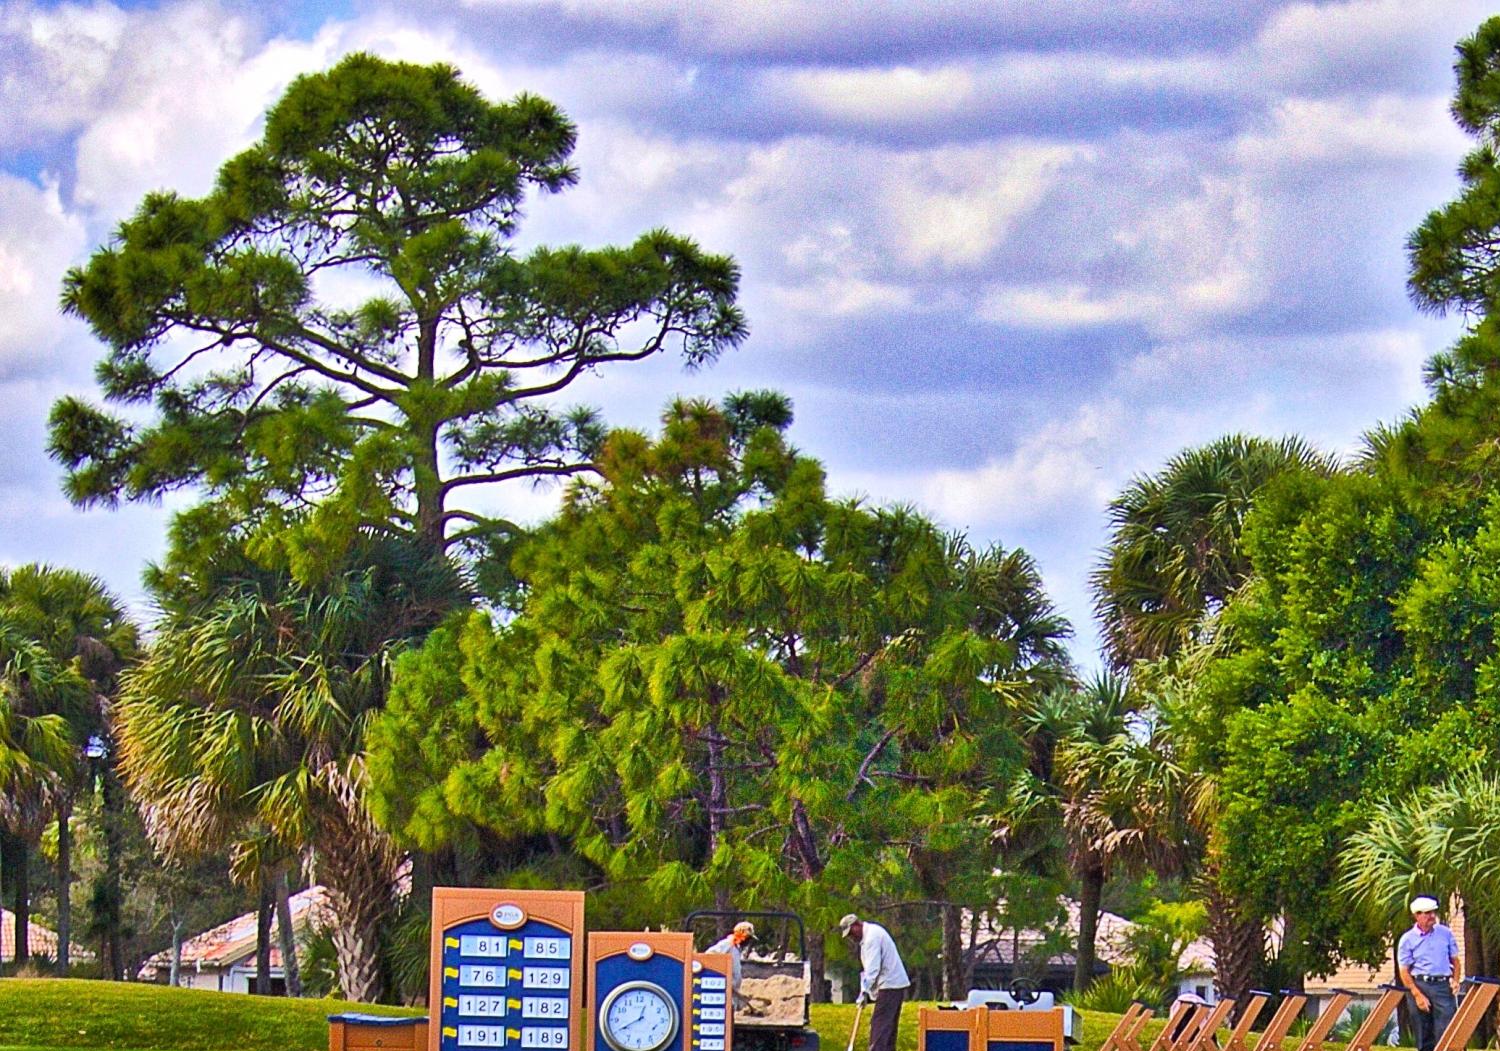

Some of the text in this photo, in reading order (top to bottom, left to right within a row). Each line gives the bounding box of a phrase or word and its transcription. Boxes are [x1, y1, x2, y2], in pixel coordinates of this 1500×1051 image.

[479, 941, 500, 952] 81
[536, 943, 557, 953] 85
[473, 971, 494, 981] 76
[530, 973, 561, 984] 129
[467, 1001, 499, 1011] 127
[529, 1002, 561, 1013] 182
[467, 1030, 497, 1041] 191
[528, 1032, 563, 1043] 189
